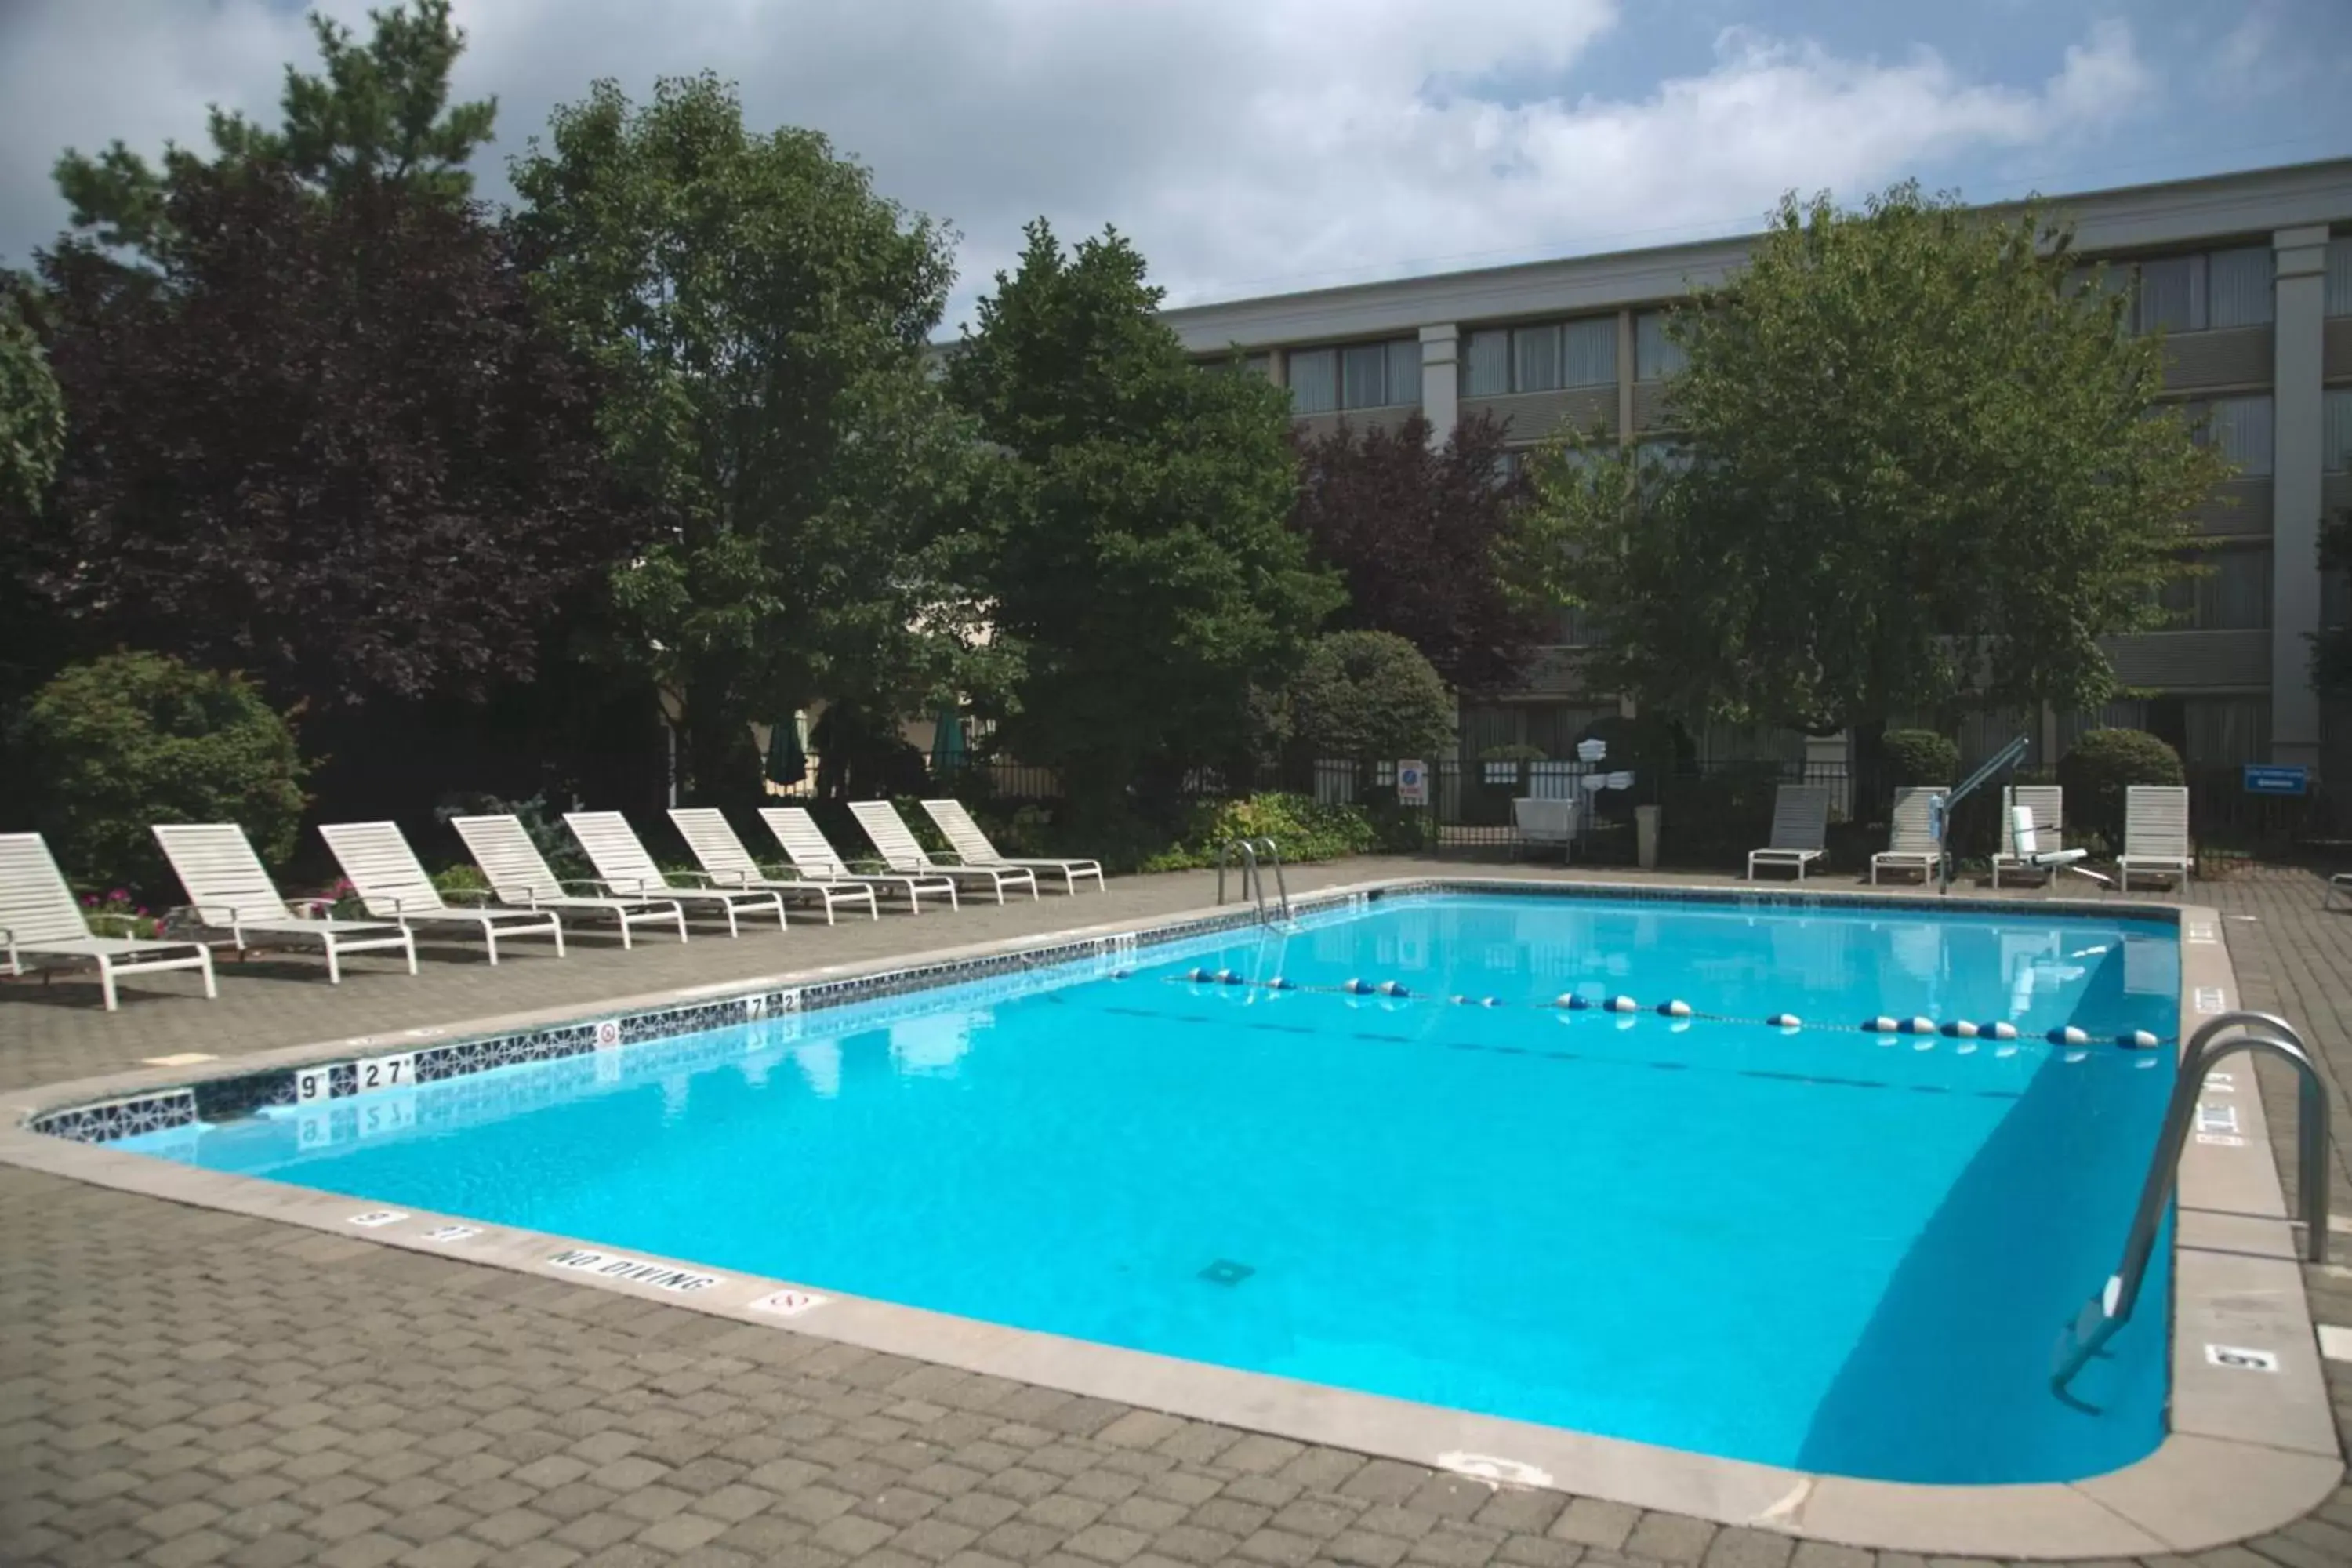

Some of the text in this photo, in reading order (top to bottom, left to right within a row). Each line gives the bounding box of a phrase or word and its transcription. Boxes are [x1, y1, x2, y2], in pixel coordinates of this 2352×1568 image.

[752, 998, 763, 1021] 7
[301, 1076, 317, 1099] 9
[550, 1250, 715, 1291] NO DIVING
